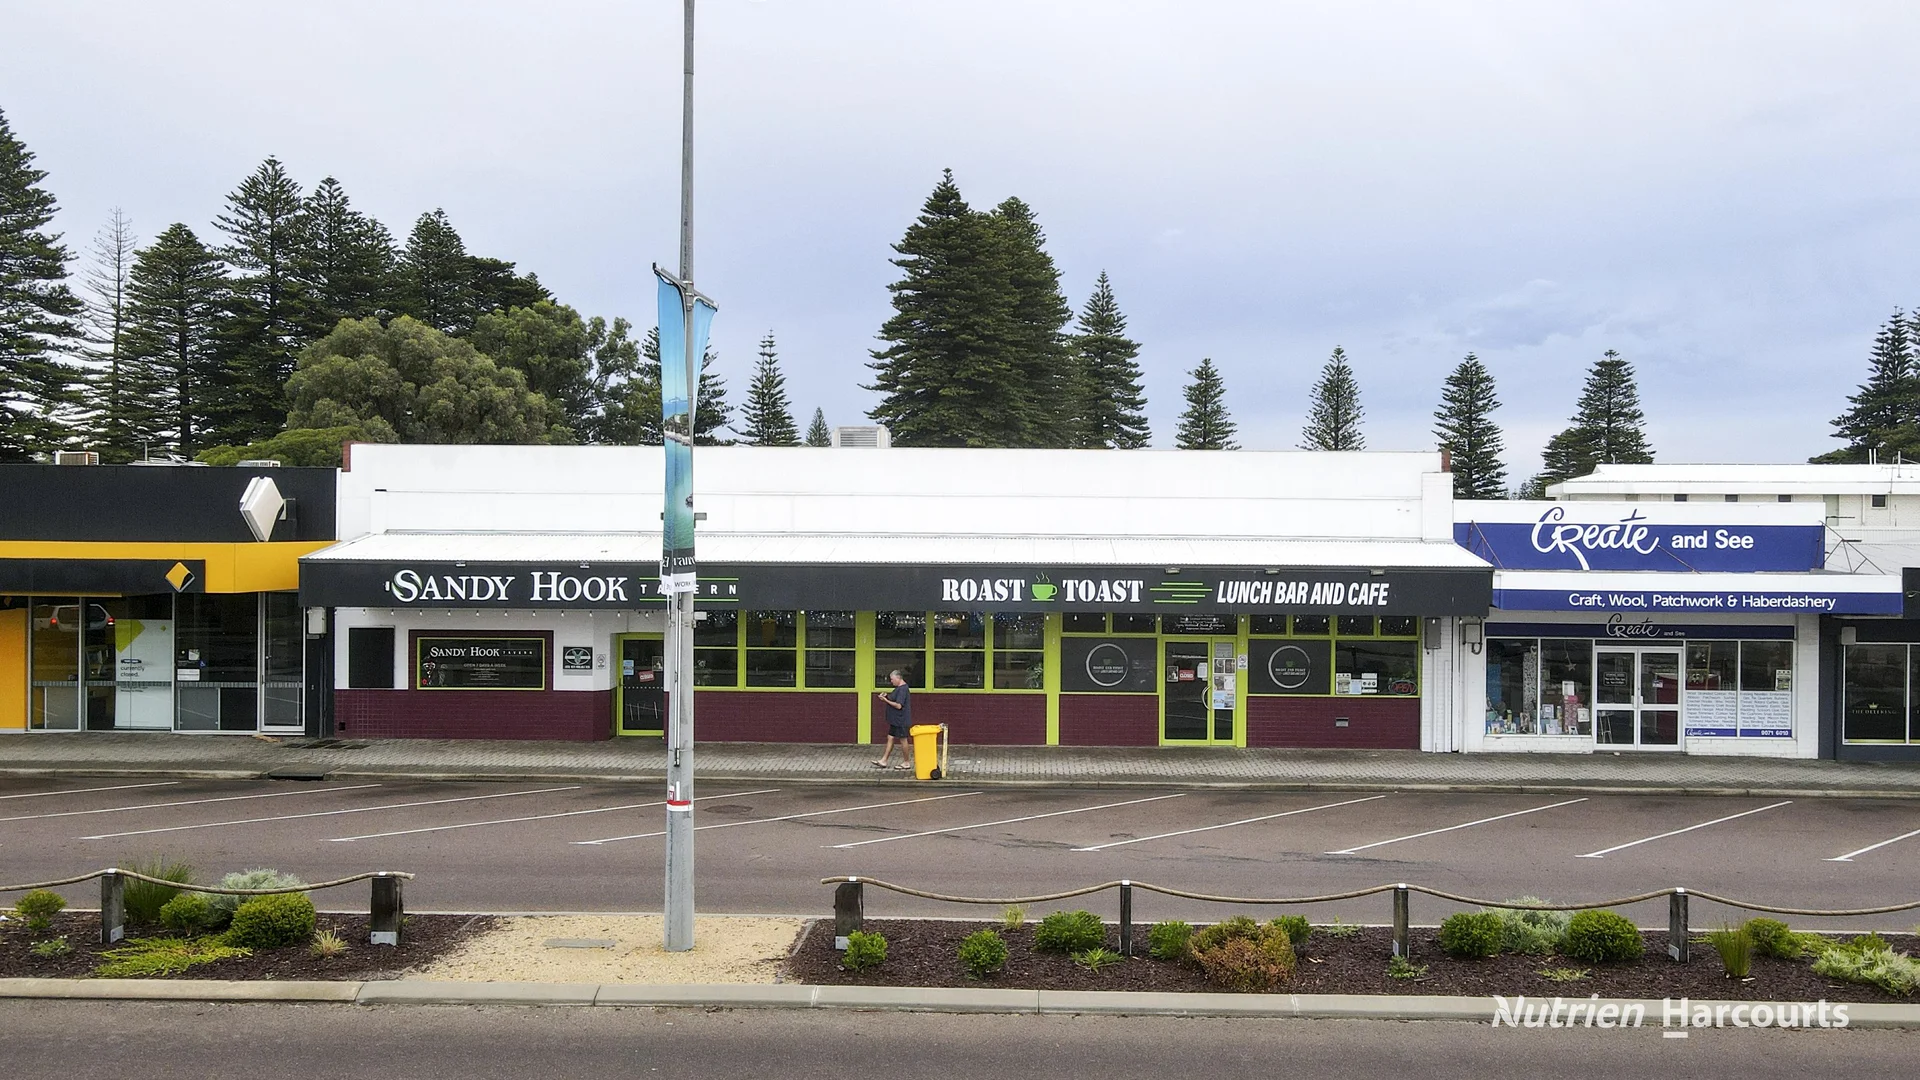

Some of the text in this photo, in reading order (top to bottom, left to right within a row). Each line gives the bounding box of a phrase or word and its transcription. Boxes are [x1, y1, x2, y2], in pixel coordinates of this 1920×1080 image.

[1672, 530, 1708, 548] and
[1715, 530, 1754, 548] See
[391, 569, 738, 602] SANDY HOOK TAERN
[942, 578, 1026, 602] ROAST
[1062, 579, 1144, 602] TOAST
[1216, 580, 1390, 606] LUNCH BAR AND CAFE
[1568, 593, 1836, 610] Craft, Wool, Patchwork & Haberdashery
[430, 646, 466, 658] SANDY
[470, 646, 500, 657] HOOK
